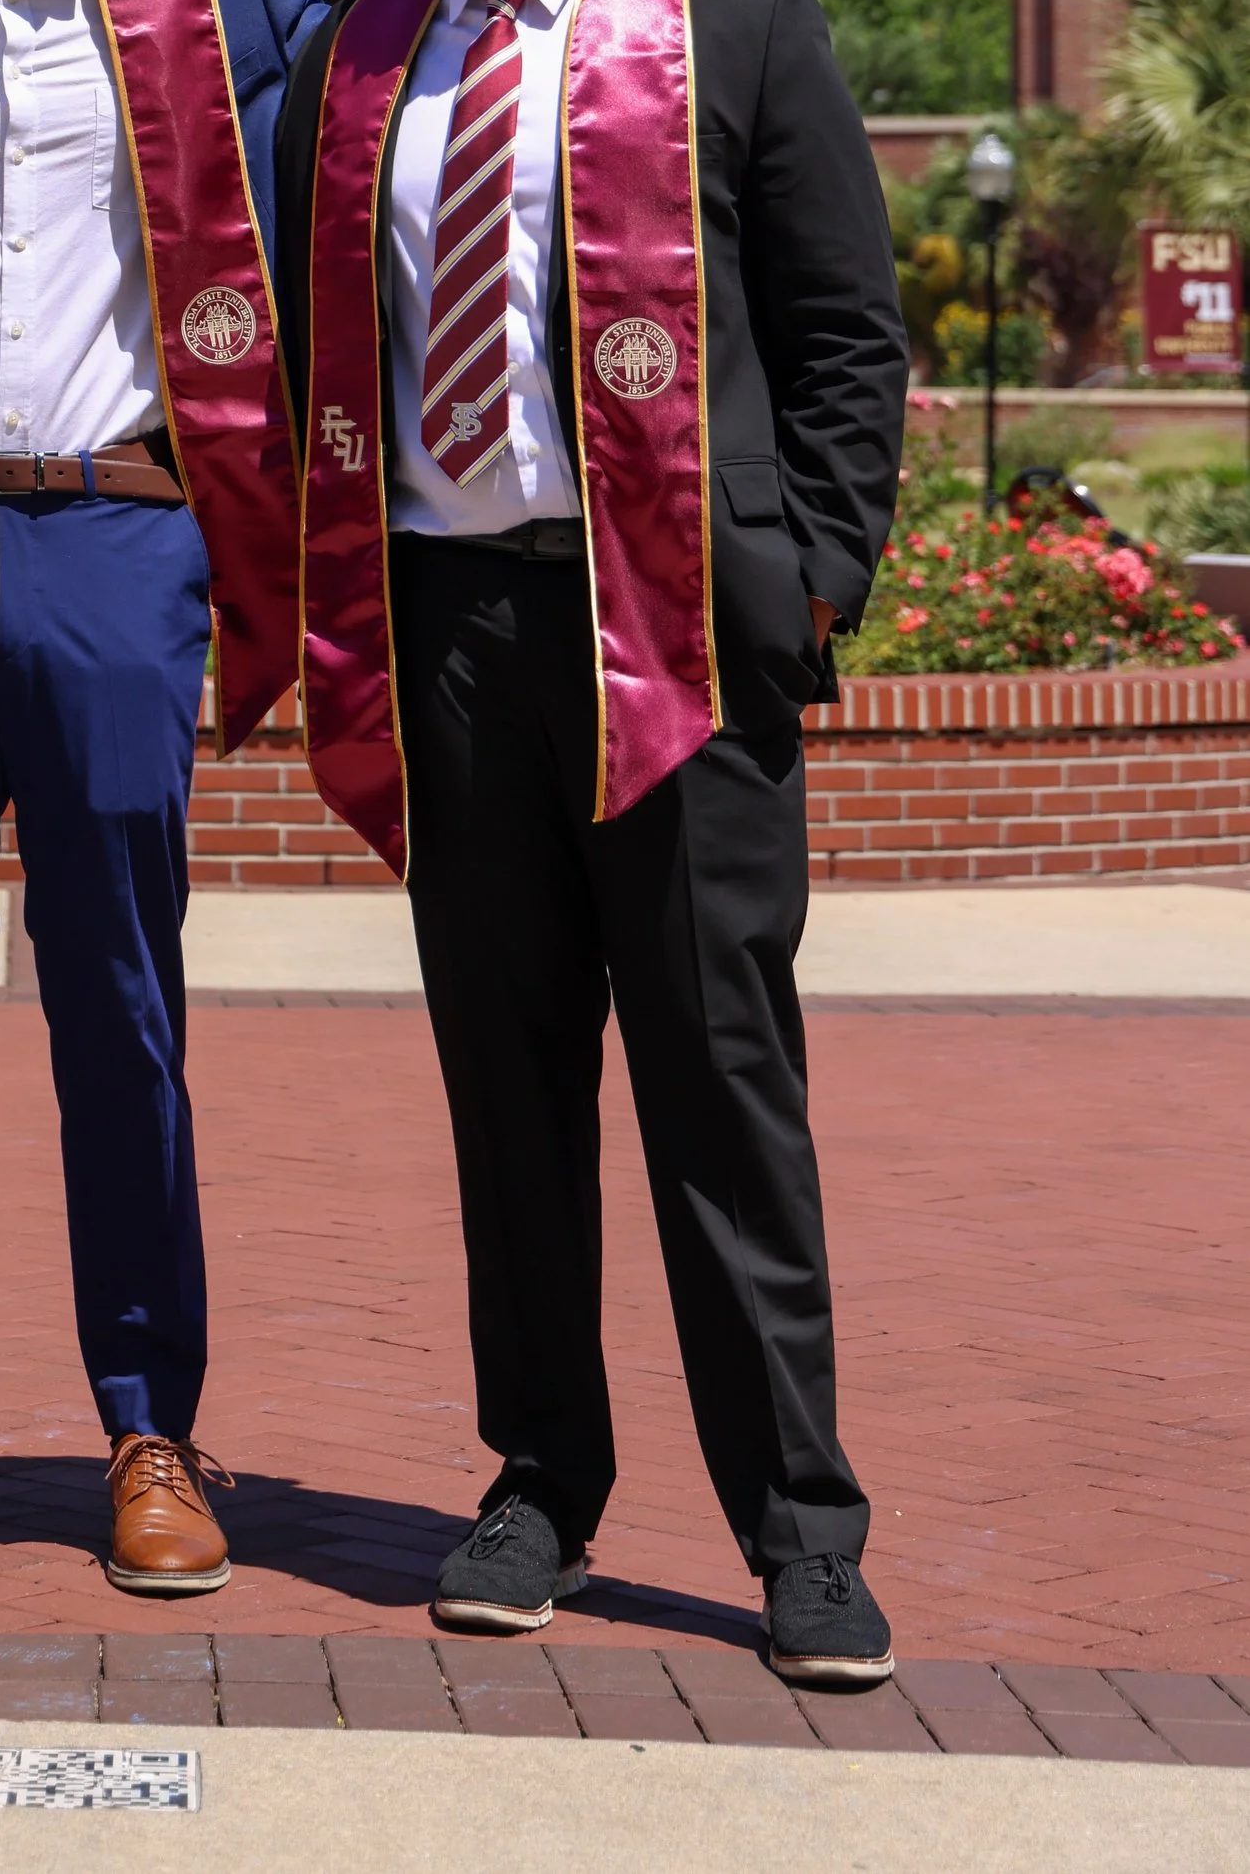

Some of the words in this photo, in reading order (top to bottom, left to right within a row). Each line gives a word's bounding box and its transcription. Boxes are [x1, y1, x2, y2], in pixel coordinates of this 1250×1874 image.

[1152, 232, 1231, 272] FSU
[186, 307, 200, 349] FLORIDA
[196, 291, 223, 307] STATE
[225, 292, 252, 342] UNIVERSITY
[214, 350, 233, 360] 1851
[599, 337, 614, 381] FLORIDA
[613, 322, 642, 337] STATE
[645, 325, 672, 380] UNIVERSITY
[627, 386, 648, 395] 1851
[319, 405, 365, 472] FSU
